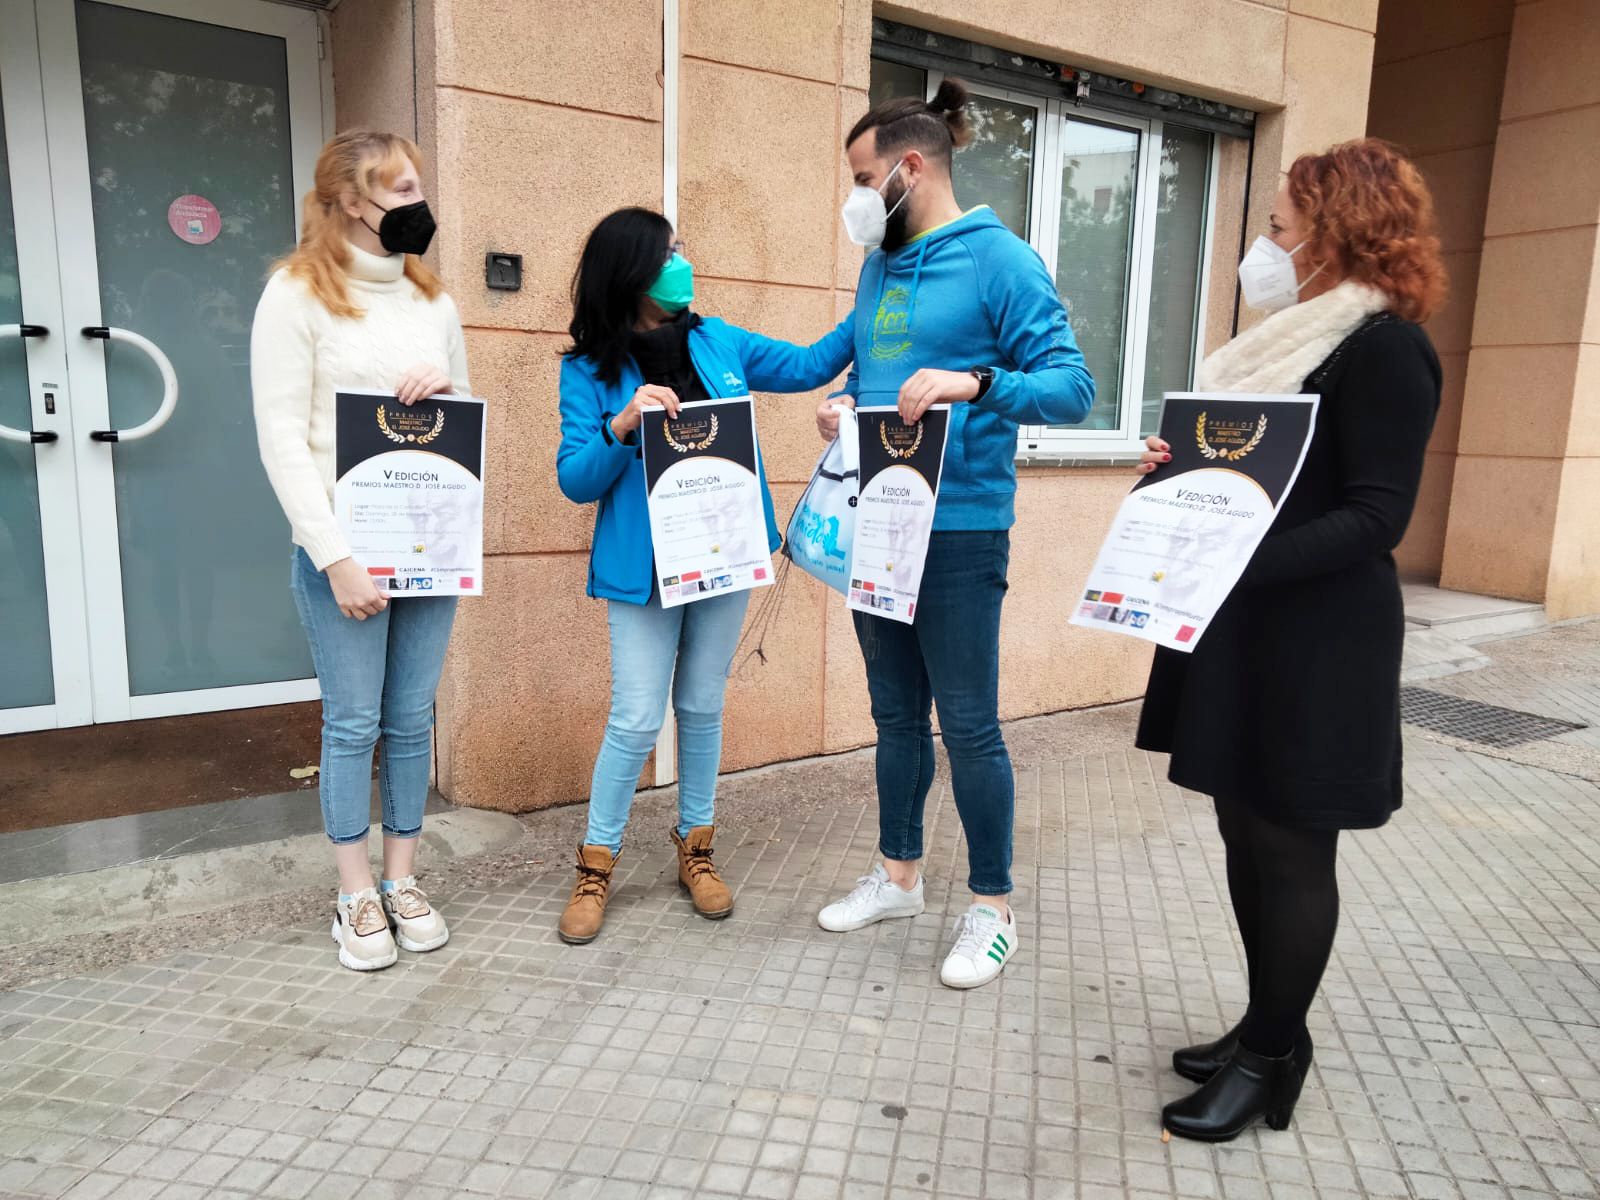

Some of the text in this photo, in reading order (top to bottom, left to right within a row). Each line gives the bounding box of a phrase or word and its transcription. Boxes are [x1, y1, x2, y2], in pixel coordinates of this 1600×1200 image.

[383, 469, 439, 482] V EDICIÓN
[383, 482, 414, 490] MAESTRO
[425, 482, 440, 490] JOSÉ
[675, 479, 684, 489] V
[882, 484, 911, 497] V EDICIÓN
[1176, 488, 1232, 506] V EDICIÓN
[1139, 495, 1168, 505] PREMIOS
[1168, 500, 1198, 509] MAESTRO
[1208, 507, 1227, 515] JOSÉ
[1226, 509, 1255, 518] AGUDO
